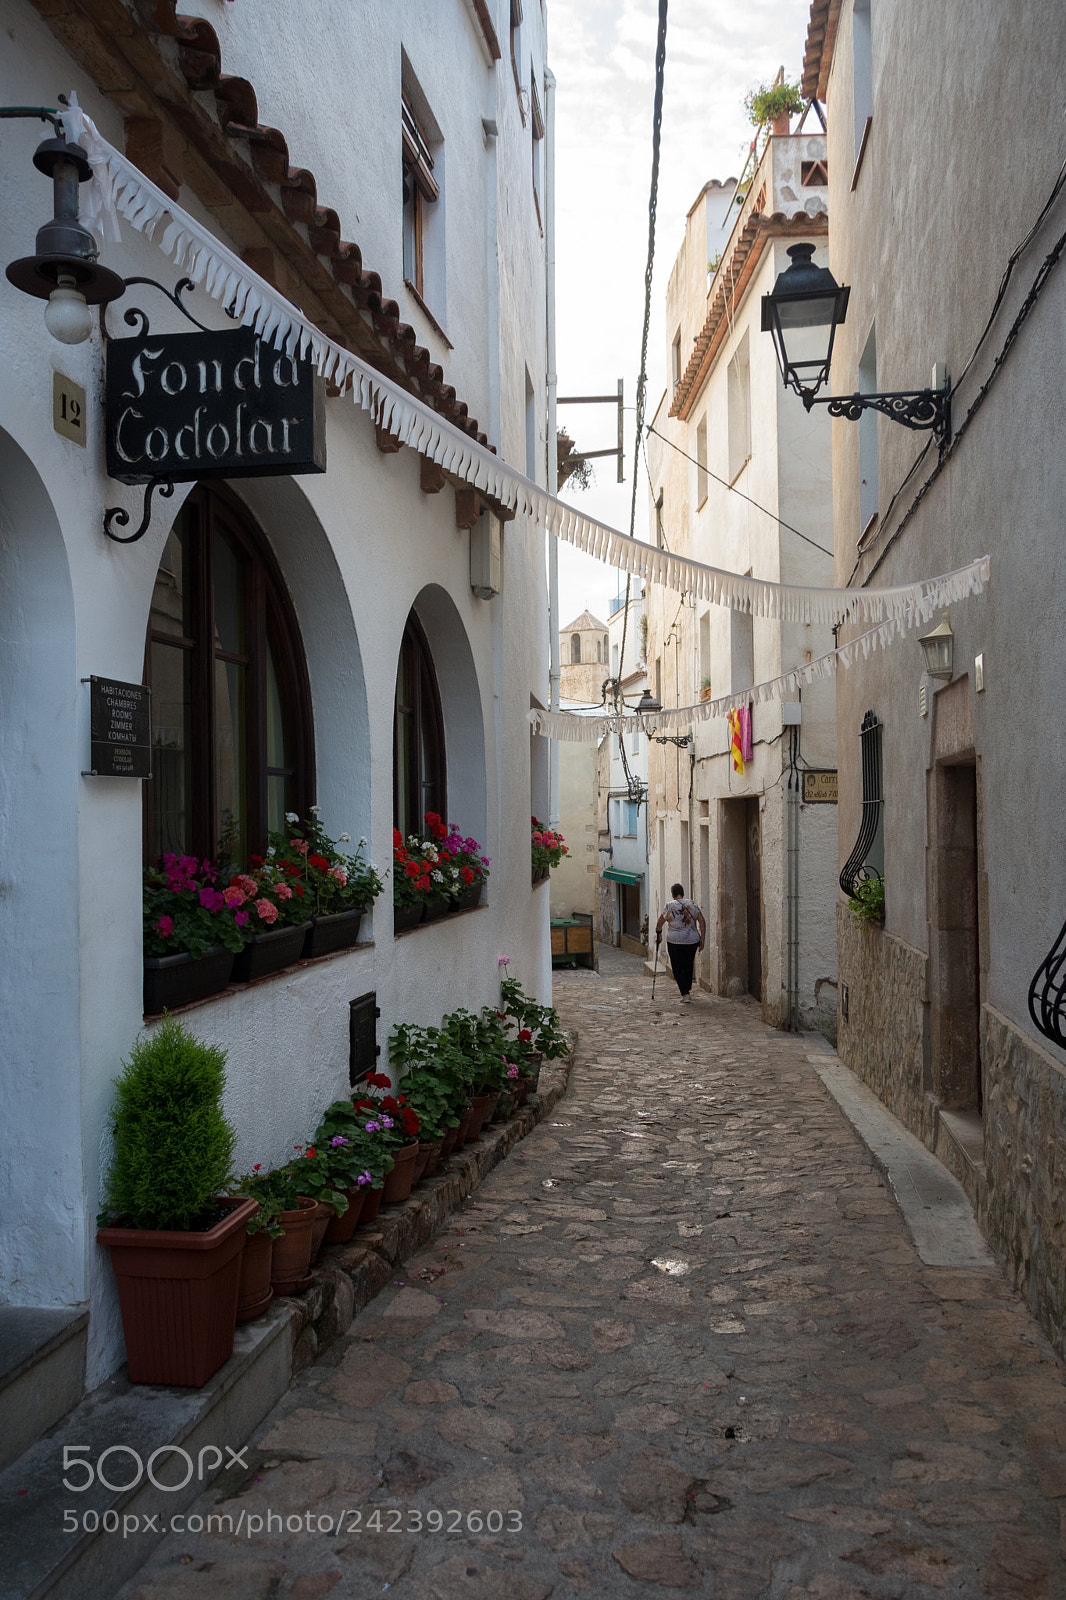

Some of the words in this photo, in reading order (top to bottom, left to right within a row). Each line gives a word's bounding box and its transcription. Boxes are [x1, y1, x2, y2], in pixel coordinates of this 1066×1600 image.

[121, 337, 299, 399] Fonda
[59, 392, 81, 428] 12
[116, 402, 304, 463] Codolar
[101, 685, 142, 700] HABITACIONES
[106, 697, 137, 710] CHAMBRES
[111, 709, 133, 720] ROOMS
[110, 720, 133, 731] ZIMMER
[108, 731, 137, 743] КОМНАТЫ
